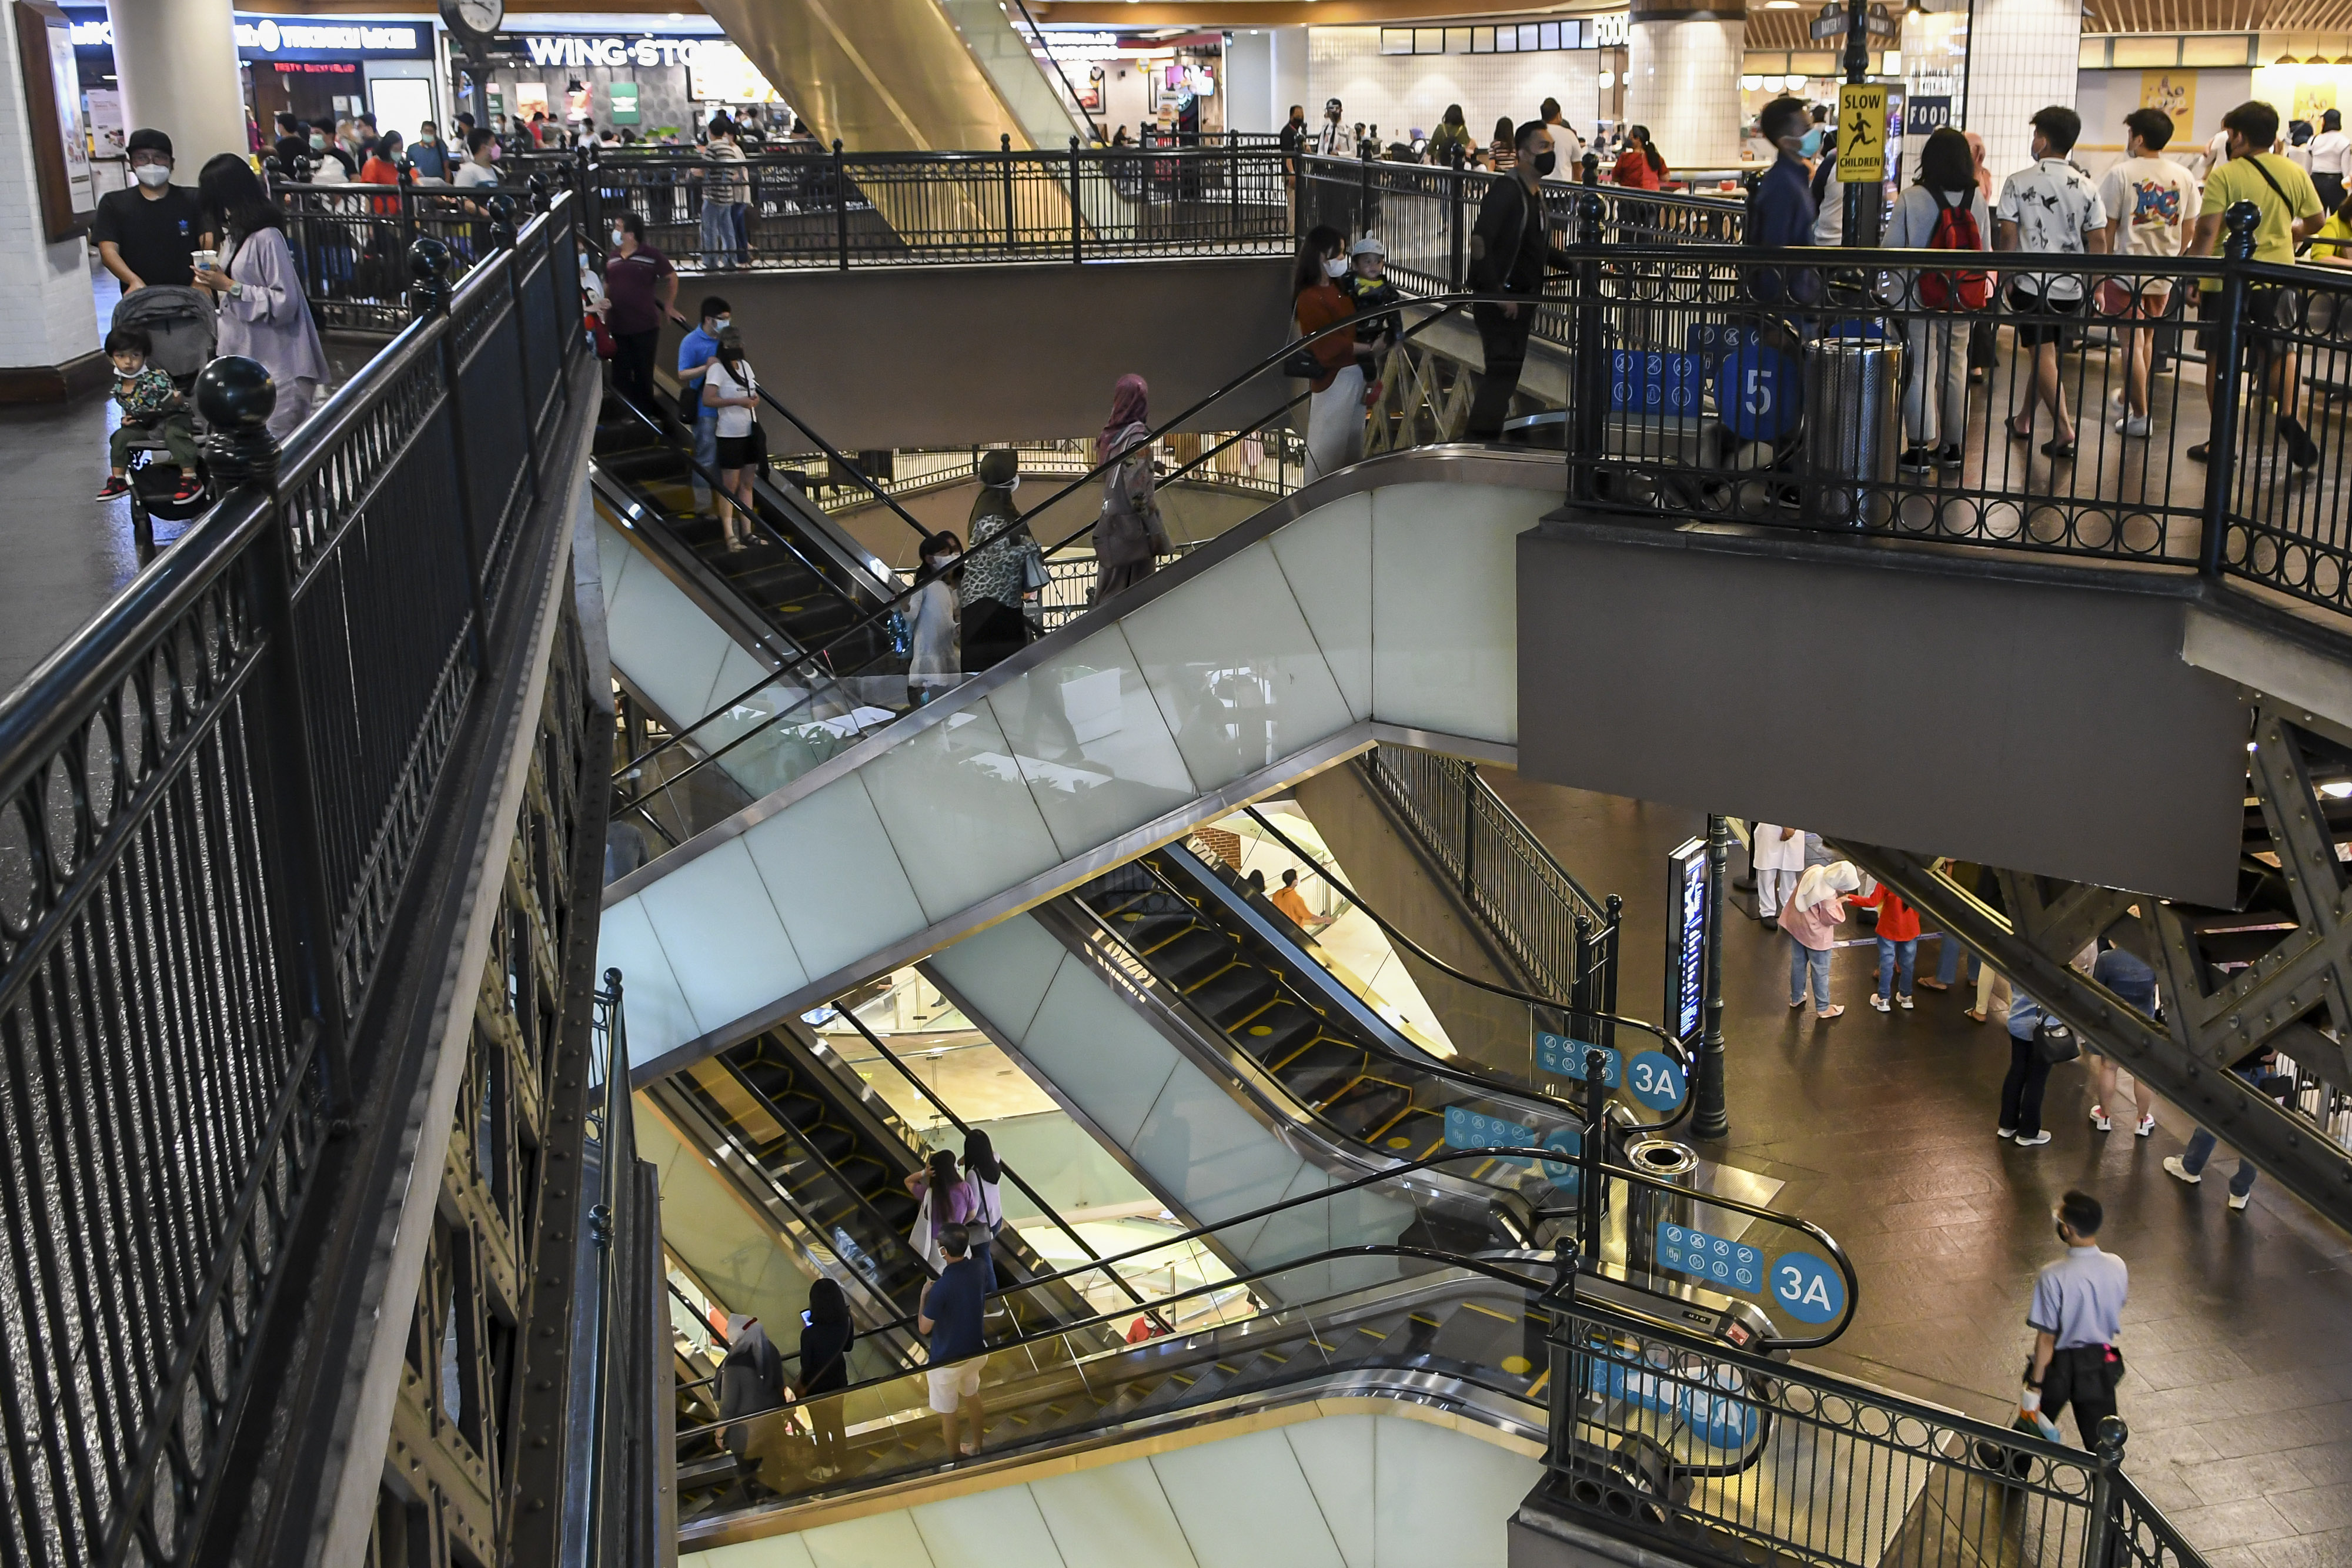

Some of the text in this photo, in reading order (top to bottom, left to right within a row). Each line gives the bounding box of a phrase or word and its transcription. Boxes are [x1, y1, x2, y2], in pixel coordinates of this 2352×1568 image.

[1845, 95, 1880, 109] SLOW
[1910, 105, 1947, 125] FOOD
[1839, 156, 1880, 167] CHILDREN
[1745, 369, 1772, 414] 5
[1635, 1063, 1676, 1099] 3A
[1780, 1266, 1831, 1311] 3A
